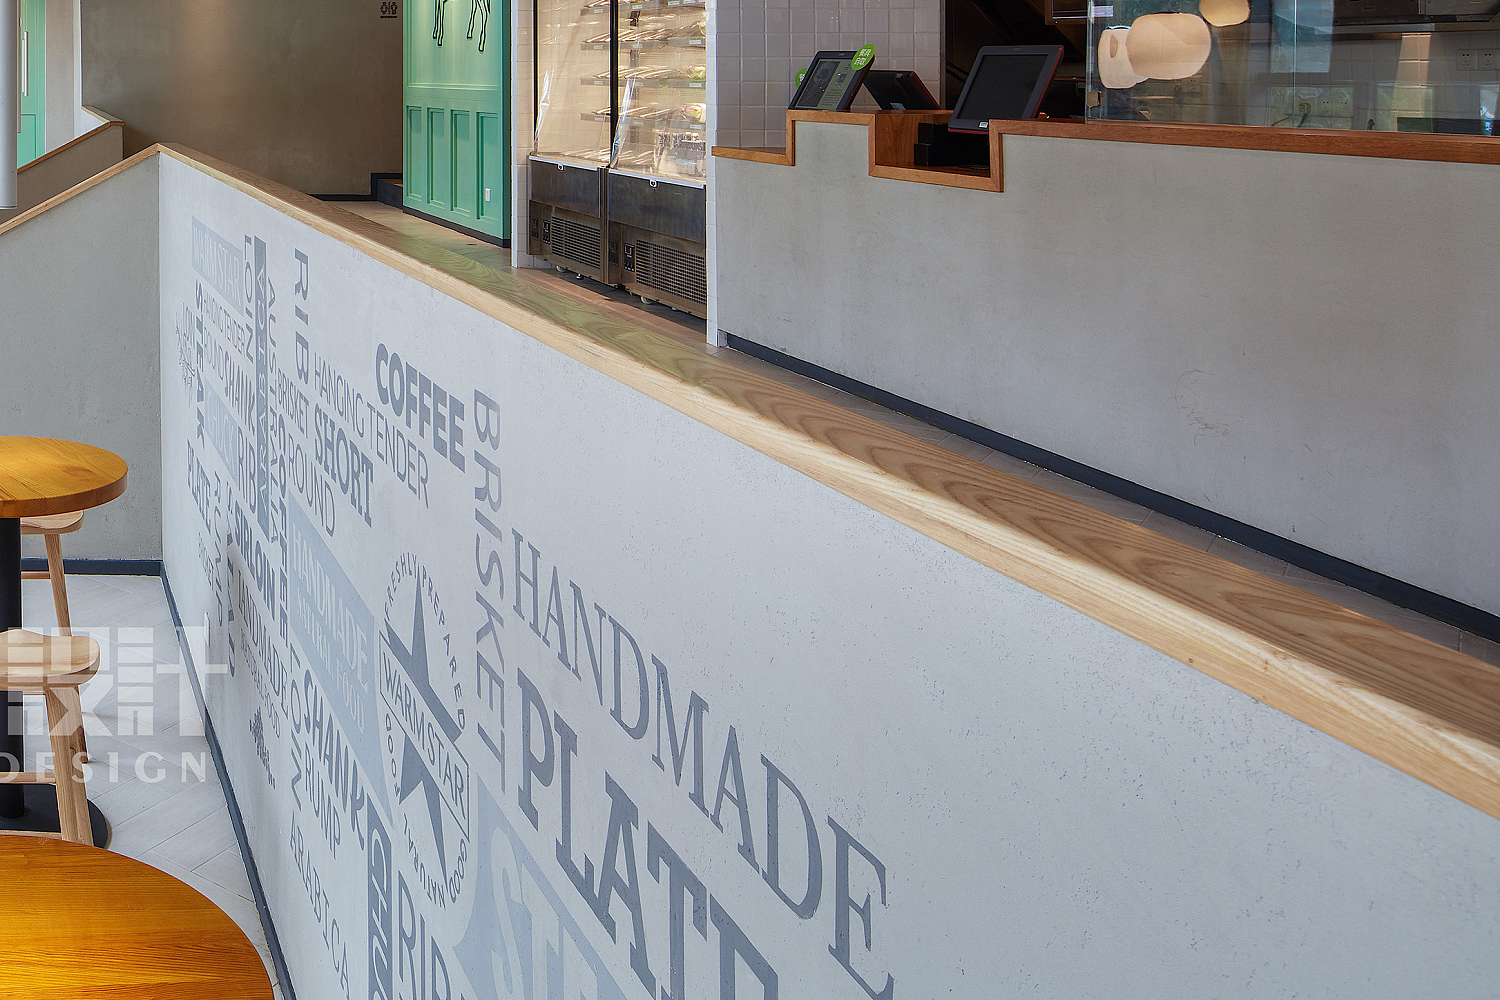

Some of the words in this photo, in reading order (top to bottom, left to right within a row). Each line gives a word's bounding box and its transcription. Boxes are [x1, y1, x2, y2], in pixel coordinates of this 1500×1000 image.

[217, 243, 241, 308] STAR
[223, 308, 245, 358] TENDER
[244, 234, 253, 364] LOIN
[294, 248, 309, 386] RIB
[224, 350, 255, 437] SHANK
[257, 265, 267, 514] ARABICA
[267, 276, 278, 543] AUSTRALIA
[277, 368, 309, 439] BRISKET
[314, 351, 364, 439] HANGING
[366, 401, 429, 509] TENDER
[375, 343, 465, 473] COFFEE
[187, 438, 211, 535] PLATE
[237, 425, 256, 514] RIB
[278, 413, 287, 648] COFFEE
[288, 431, 335, 538] ROUND
[314, 402, 374, 529] SHORT
[214, 471, 222, 627] RUMP
[234, 500, 275, 621] SIRLOIN
[292, 520, 368, 687] HANDMADE
[474, 389, 505, 795] BRISKET
[336, 658, 365, 736] FOOD
[384, 551, 418, 621] FRESHLY
[422, 564, 465, 731] PREPARED
[290, 642, 302, 812] LOIN
[304, 669, 364, 851] SHANK
[382, 651, 425, 752] WARM
[427, 723, 467, 821] STAR
[385, 713, 401, 798] FOOD
[511, 527, 894, 1000] HANDMADE
[305, 741, 342, 860] RUMP
[403, 812, 447, 911] NATURAL
[290, 810, 350, 1000] ARABICA
[371, 828, 389, 1000] CHU
[449, 838, 468, 904] GOOD
